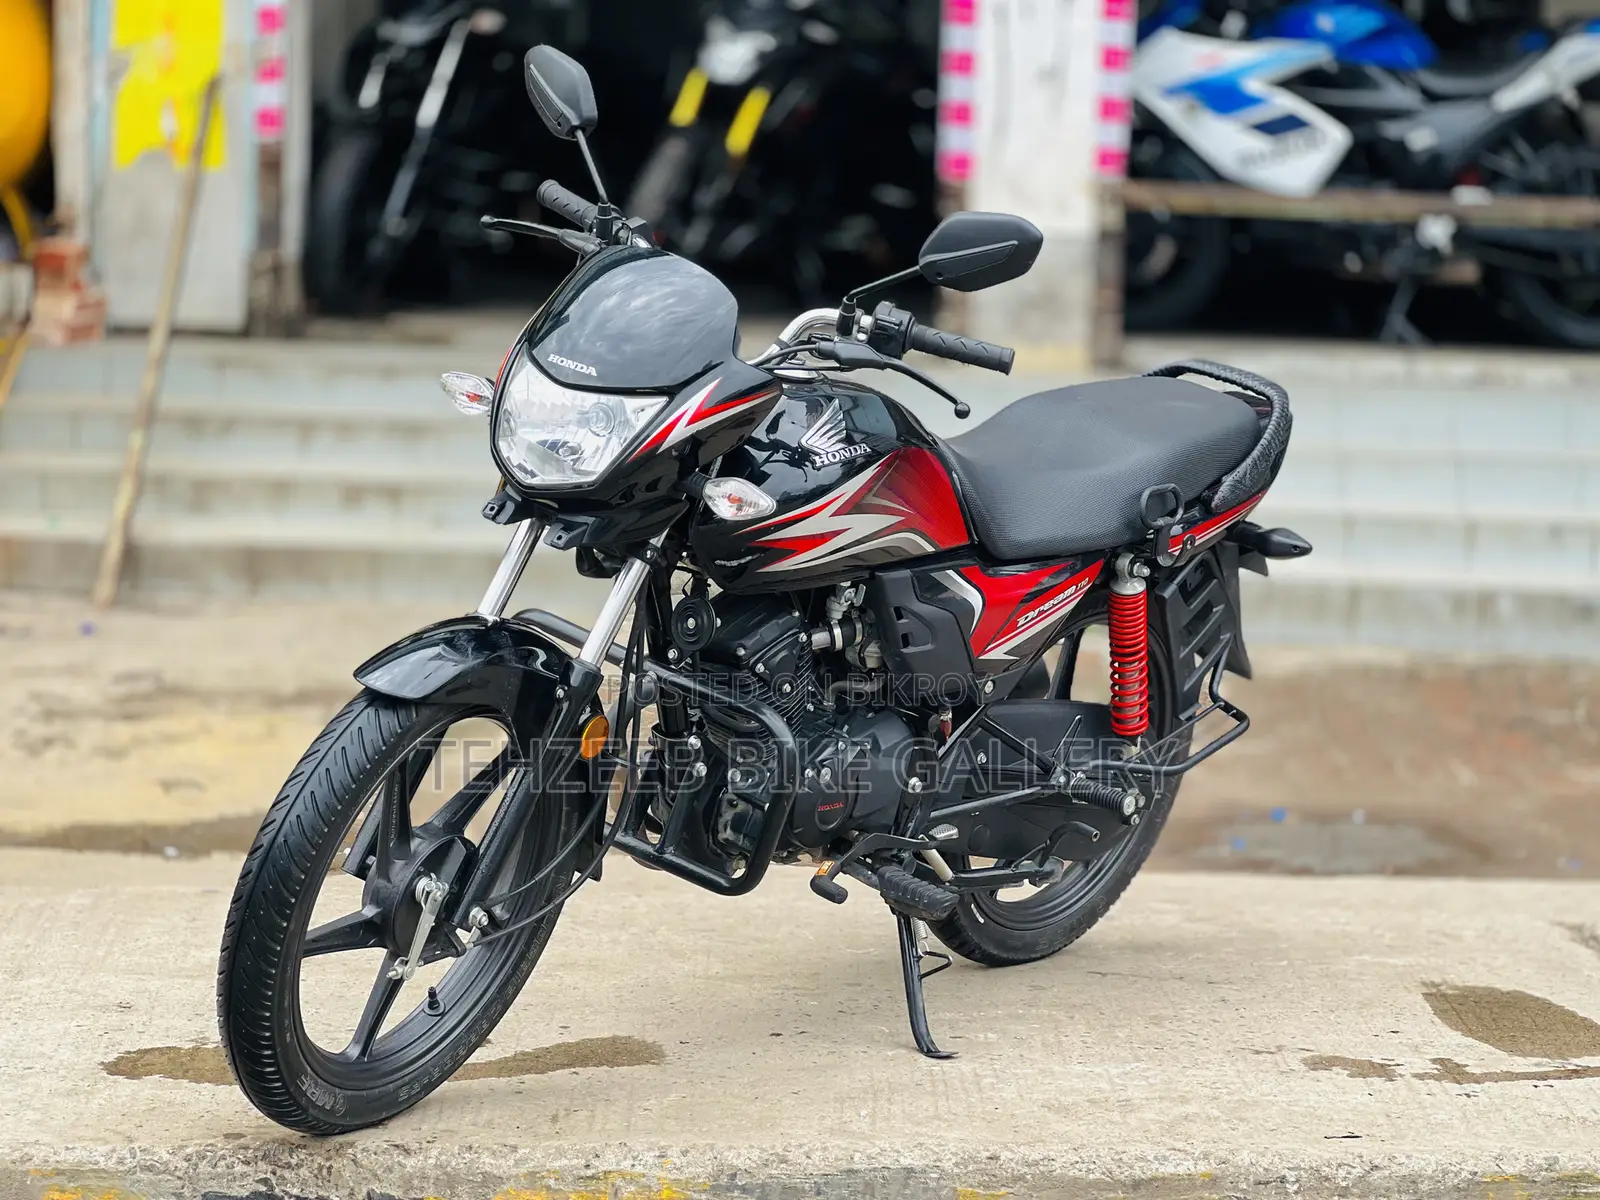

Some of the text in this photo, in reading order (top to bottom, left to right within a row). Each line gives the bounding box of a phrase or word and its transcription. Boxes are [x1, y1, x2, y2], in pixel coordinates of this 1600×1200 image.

[547, 353, 598, 377] HONDA
[812, 443, 872, 467] HONDA
[1016, 584, 1077, 628] Dream
[296, 1072, 336, 1110] MRF
